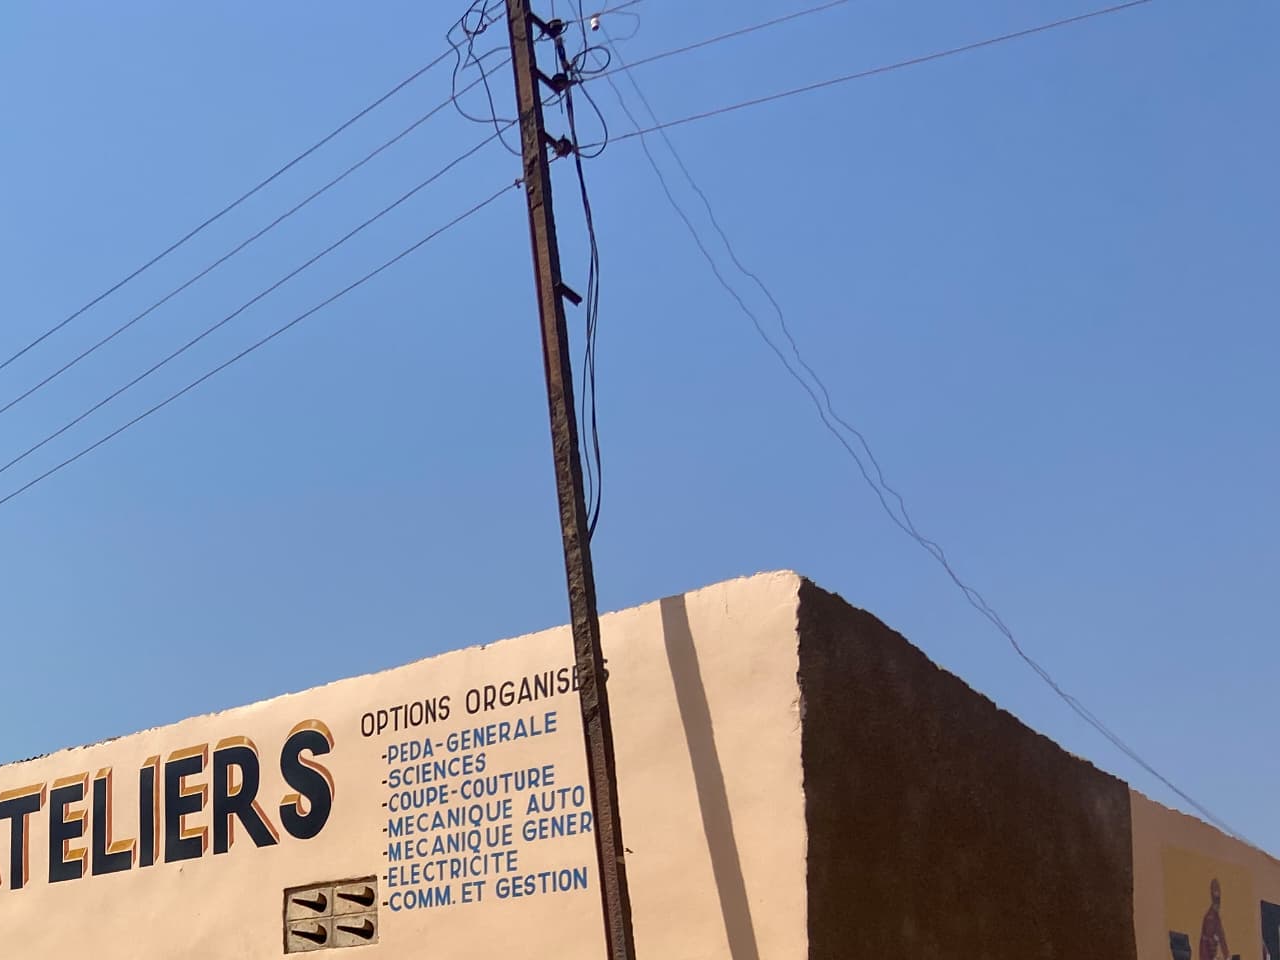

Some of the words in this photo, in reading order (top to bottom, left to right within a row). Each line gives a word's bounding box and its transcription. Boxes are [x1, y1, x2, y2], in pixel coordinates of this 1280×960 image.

[361, 696, 451, 737] OPTIONS
[465, 658, 610, 715] ORGANISE
[526, 785, 586, 816] AUTO
[461, 880, 486, 904] ET
[495, 866, 588, 899] GESTION
